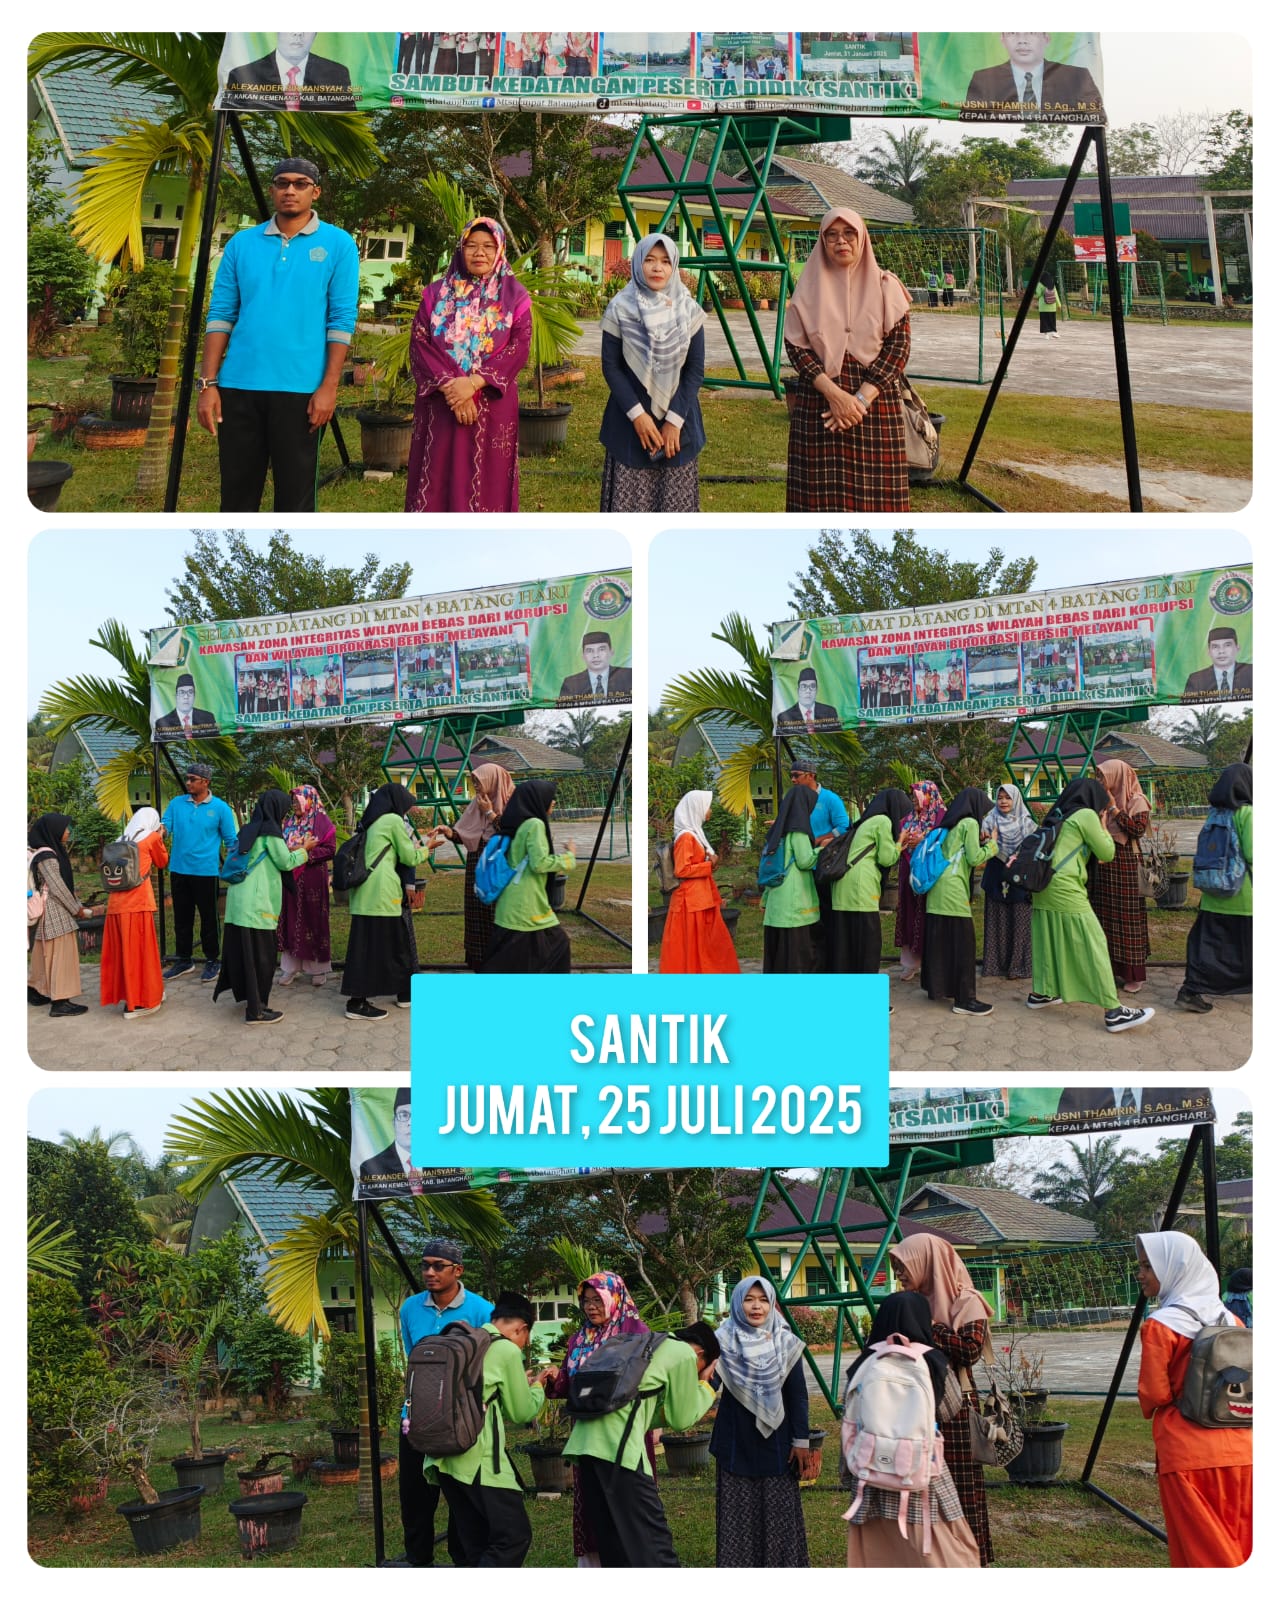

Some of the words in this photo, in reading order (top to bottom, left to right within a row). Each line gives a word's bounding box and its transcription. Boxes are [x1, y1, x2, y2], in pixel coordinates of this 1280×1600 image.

[390, 74, 490, 92] SAMBUT
[493, 76, 638, 95] KEDATANGAN
[642, 77, 738, 96] PESERTA
[743, 80, 810, 97] DIDIK
[814, 81, 919, 99] (SANTIK)
[958, 112, 997, 121] KEPALA
[1036, 113, 1100, 122] BATANGHARI
[199, 624, 271, 641] SELAMAT
[275, 615, 345, 634] DATANG
[350, 611, 369, 624] DI
[374, 604, 419, 620] MTsN
[424, 600, 433, 615] 4
[437, 592, 514, 613] BATANG
[520, 585, 569, 604] HARI
[821, 616, 895, 635] SELAMAT
[900, 609, 970, 628] DATANG
[974, 604, 994, 619] DI
[997, 599, 1043, 615] MTsN
[1049, 597, 1058, 611] 4
[1061, 588, 1139, 609] BATANG
[1144, 580, 1196, 599] HARI
[821, 634, 879, 649] KAWASAN
[881, 632, 910, 644] ZONA
[913, 622, 985, 640] INTEGRITAS
[987, 615, 1043, 632] WILAYAH
[1047, 608, 1090, 625] BEBAS
[1093, 604, 1127, 620] DARI
[1130, 598, 1194, 616] KORUPSI
[199, 640, 256, 655] KAWASAN
[258, 637, 288, 650] ZONA
[290, 628, 361, 646] INTEGRITAS
[363, 622, 419, 637] WILAYAH
[422, 616, 465, 631] BEBAS
[468, 611, 501, 625] DARI
[504, 603, 568, 620] KORUPSI
[245, 652, 269, 664] DAN
[271, 647, 323, 662] WILAYAH
[326, 638, 395, 655] BIROKRASI
[397, 630, 446, 646] BERSIH
[447, 624, 514, 642] MELAYANI
[867, 646, 892, 658] DAN
[895, 641, 946, 656] WILAYAH
[949, 632, 1019, 650] BIROKRASI
[1021, 625, 1069, 642] BERSIH
[1072, 618, 1139, 637] MELAYANI
[235, 709, 287, 724] SAMBUT
[288, 703, 367, 720] KEDATANGAN
[369, 697, 425, 713] PESERTA
[426, 694, 466, 710] DIDIK
[467, 688, 530, 705] (SANTIK)
[857, 704, 910, 719] SAMBUT
[911, 698, 989, 715] KEDATANGAN
[991, 692, 1048, 708] PESERTA
[1049, 688, 1090, 704] DIDIK
[1091, 683, 1154, 700] (SANTIK)
[895, 1101, 1005, 1127] (SANTIK)
[1044, 1112, 1081, 1122] HUSNI
[1048, 1123, 1090, 1134] KEPALA
[1133, 1111, 1207, 1126] BATANGHARI
